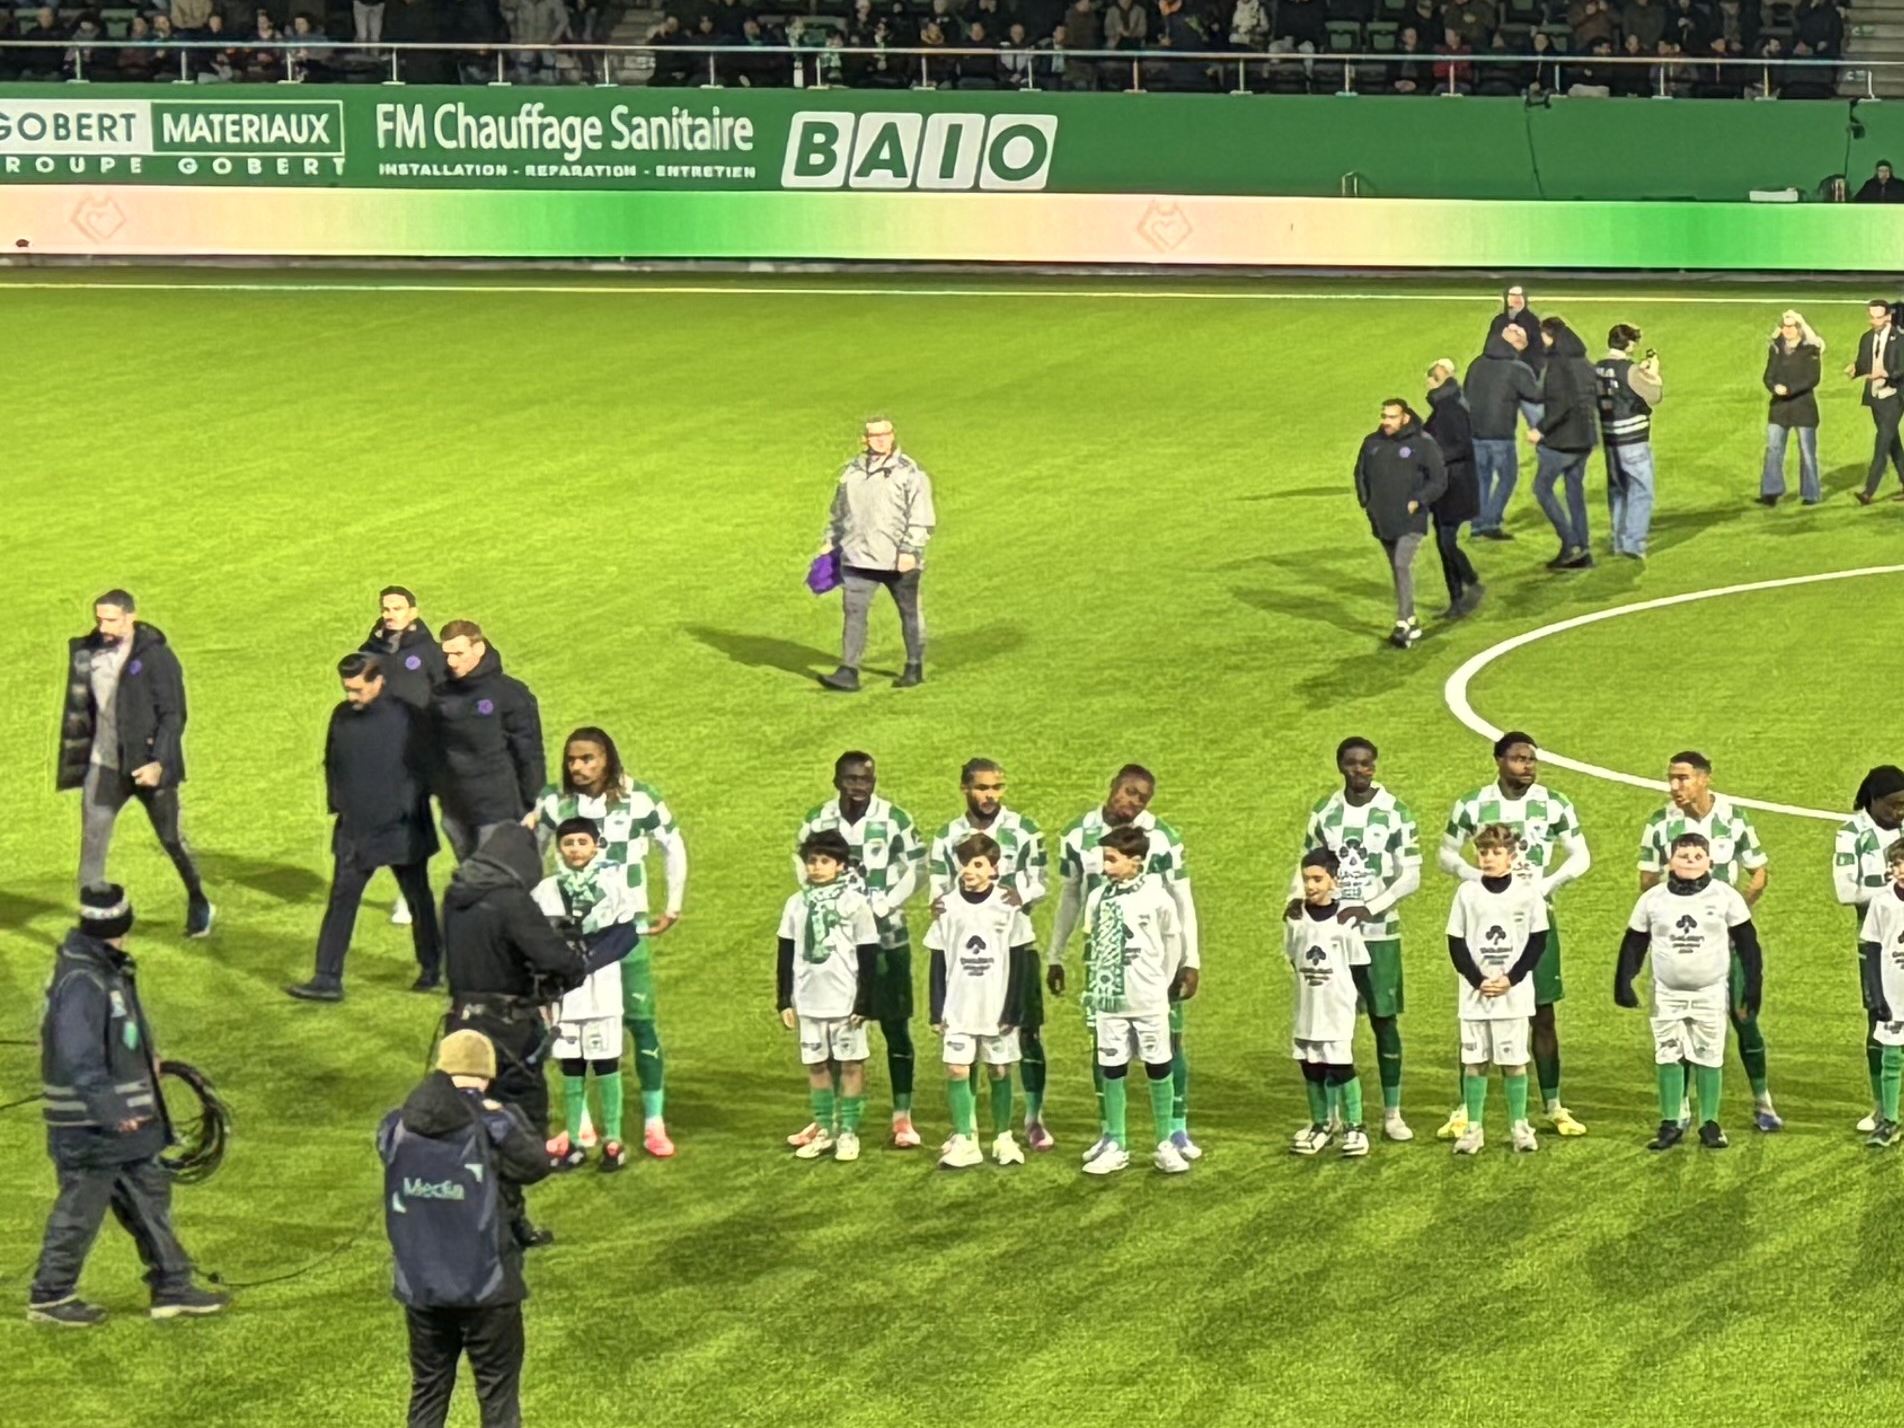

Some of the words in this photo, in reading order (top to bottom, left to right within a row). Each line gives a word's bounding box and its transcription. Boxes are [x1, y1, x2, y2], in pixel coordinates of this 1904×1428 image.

[163, 113, 331, 144] MATERIAUX
[376, 103, 426, 149] FM
[433, 102, 603, 162] Chauffage
[611, 105, 754, 151] Sanitaire
[5, 156, 143, 174] ROUPE
[178, 156, 346, 176] GOBERT
[793, 121, 1048, 182] BAIO
[379, 163, 508, 177] INSTALLATION
[525, 164, 637, 178] REPARATION
[656, 165, 756, 179] ENTRETIEN
